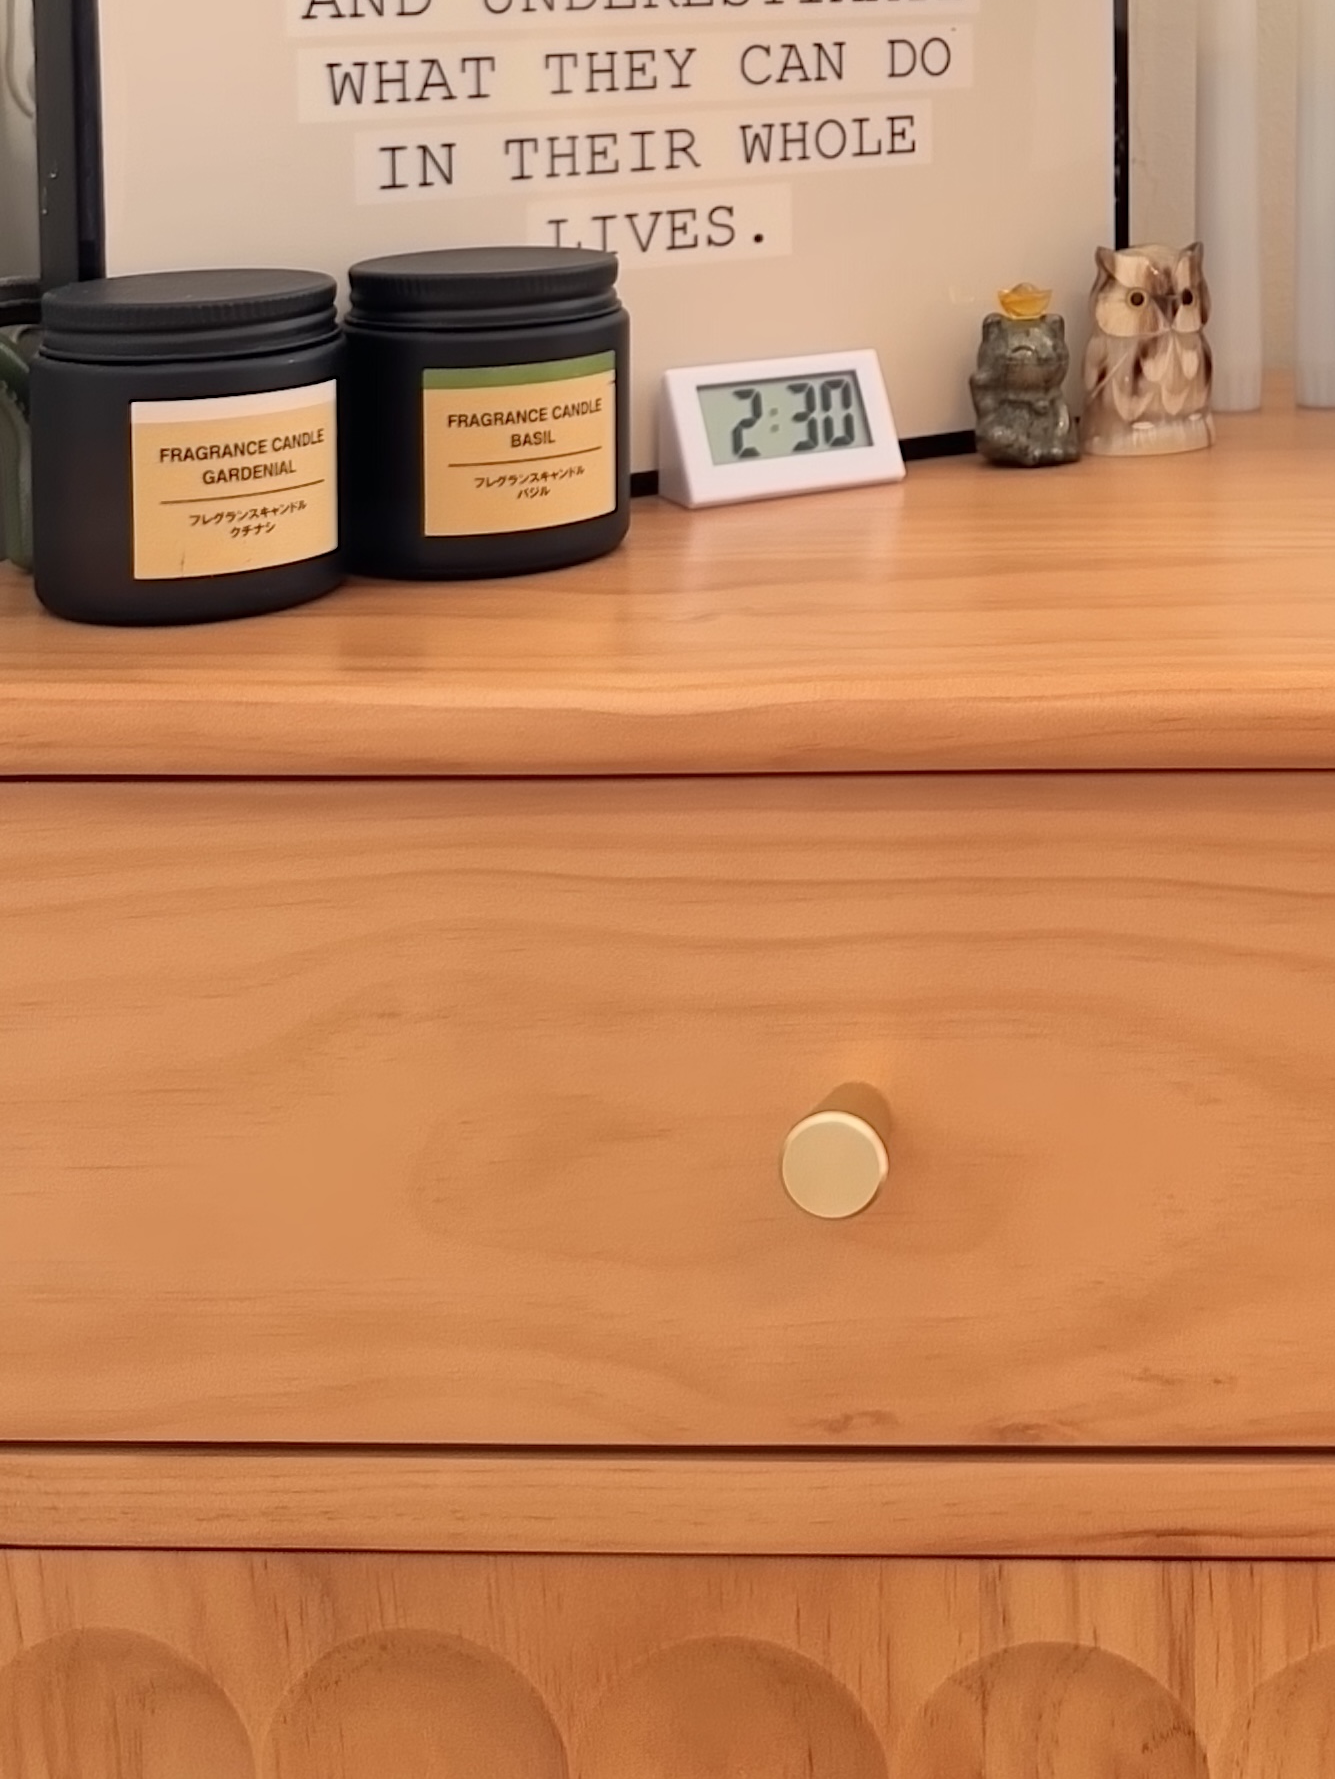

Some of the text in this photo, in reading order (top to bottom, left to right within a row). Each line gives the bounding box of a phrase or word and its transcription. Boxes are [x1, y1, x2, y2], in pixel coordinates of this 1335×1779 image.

[325, 36, 952, 106] WHAT THEY CAN DO
[378, 114, 917, 191] IN THEIR WHOLE
[446, 397, 603, 429] FRAGRANCE CANDLE
[731, 378, 855, 459] 2:30
[158, 427, 326, 464] FRAGRANCE CANDLE
[509, 429, 557, 449] BASIL
[201, 459, 298, 486] GARDENIAL
[227, 521, 277, 539] クチナシ
